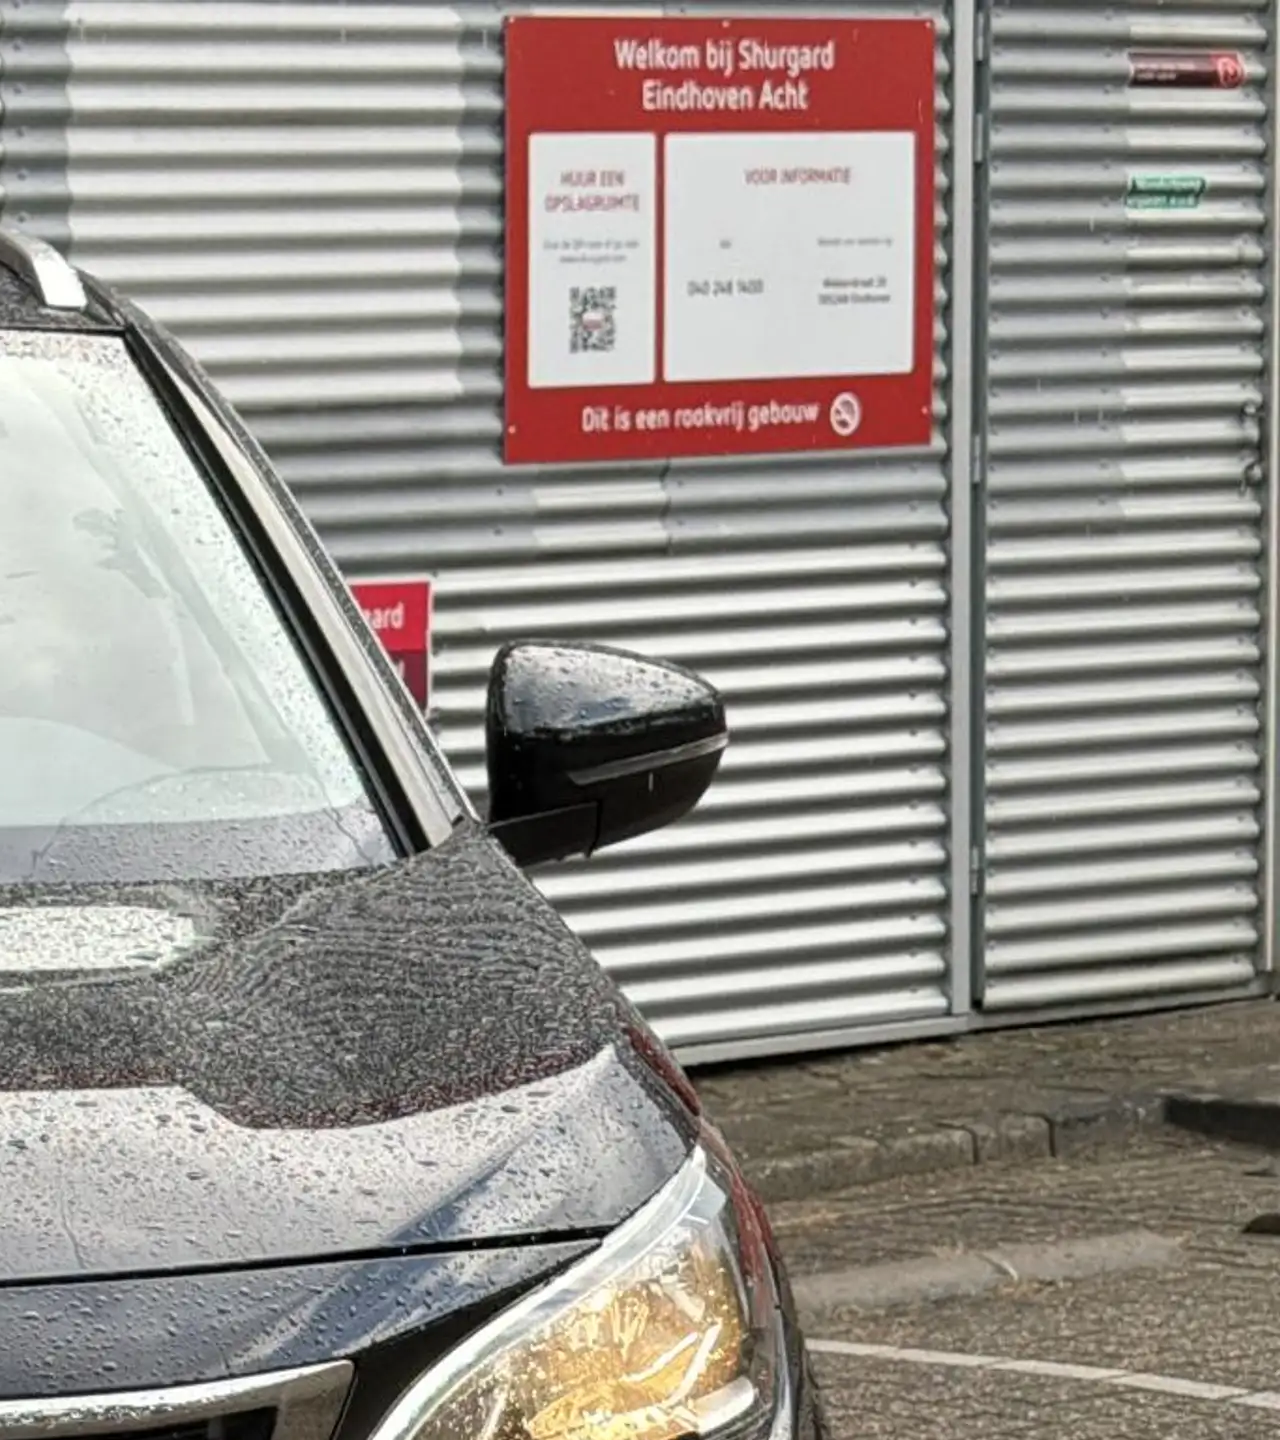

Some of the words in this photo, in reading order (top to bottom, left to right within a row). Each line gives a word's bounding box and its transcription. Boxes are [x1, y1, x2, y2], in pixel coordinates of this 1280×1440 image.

[613, 37, 700, 70] Welkom
[705, 38, 734, 78] bij
[738, 37, 835, 79] Shurgard
[641, 78, 754, 112] Eindhoven
[758, 78, 809, 111] Acht
[744, 167, 778, 185] VOOR
[781, 166, 852, 185] INFORMATIE
[581, 406, 609, 432] Dit
[614, 405, 631, 431] is
[635, 407, 670, 430] een
[674, 401, 746, 432] rookvrij
[747, 400, 821, 431] gebouw
